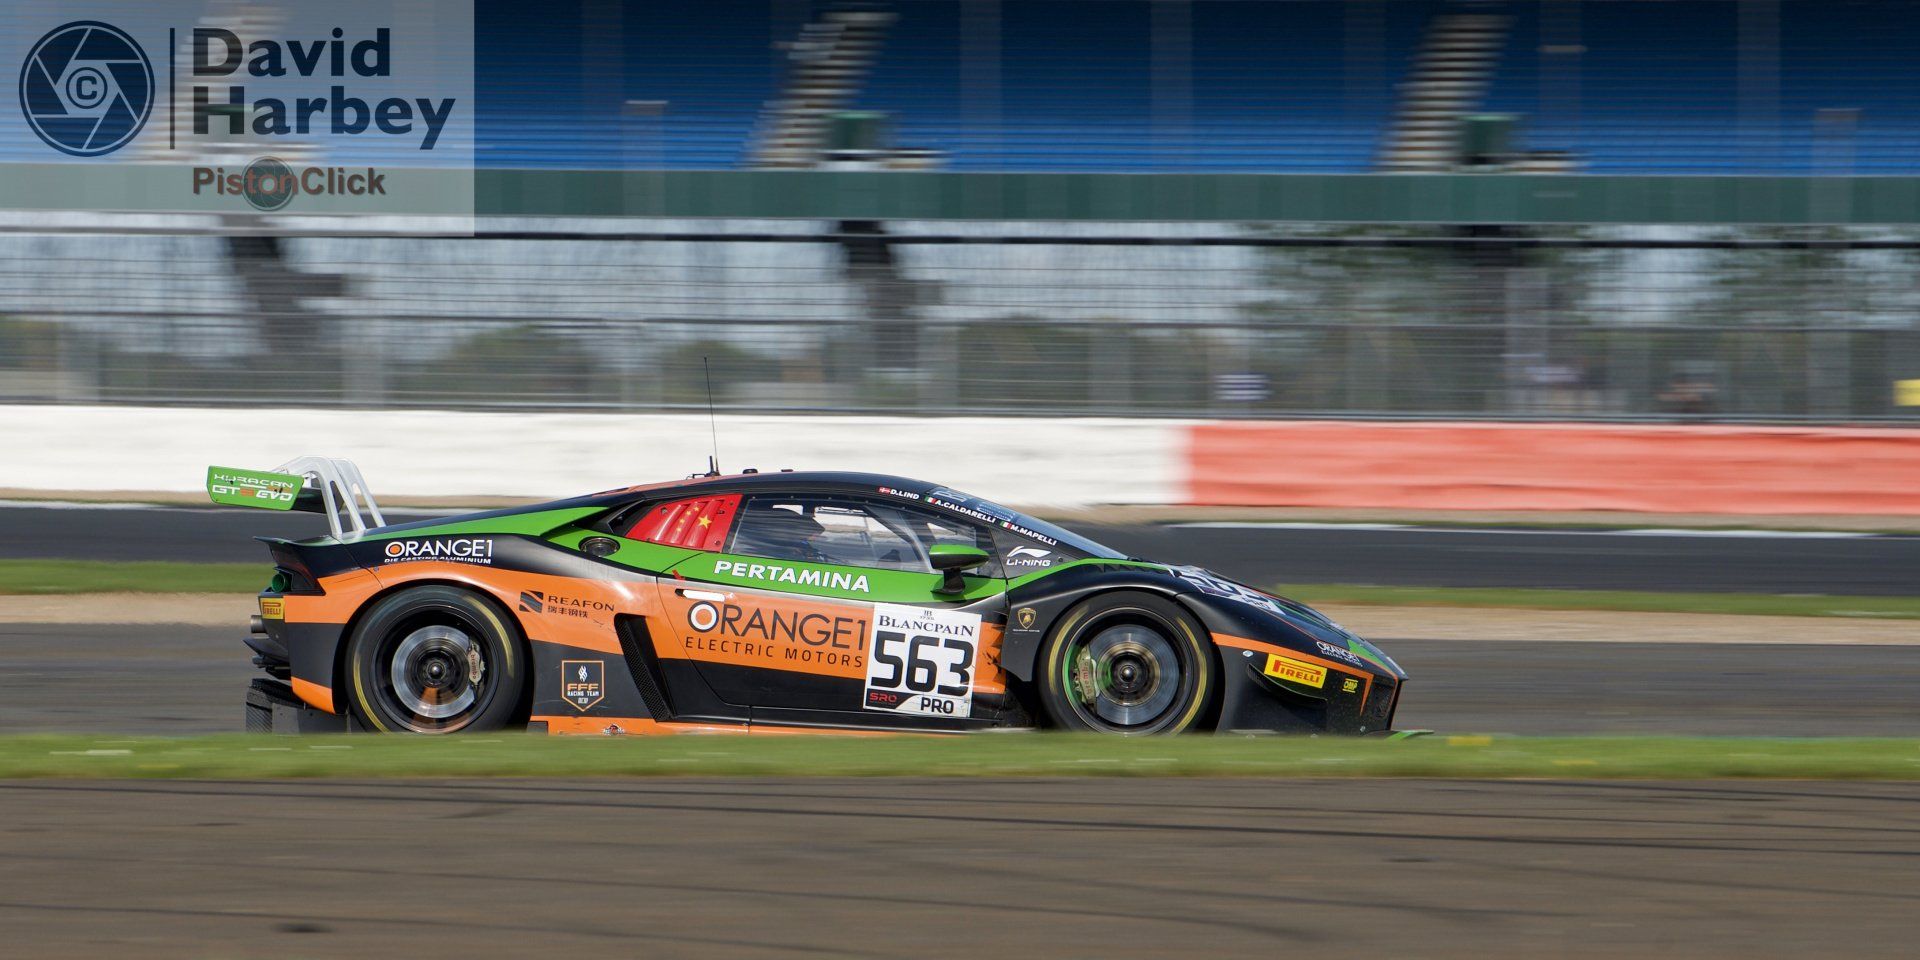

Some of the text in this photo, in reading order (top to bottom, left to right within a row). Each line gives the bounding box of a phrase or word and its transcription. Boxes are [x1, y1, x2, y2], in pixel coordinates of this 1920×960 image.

[890, 488, 920, 500] D.LIND
[934, 500, 996, 524] A.CALDARELLI
[1010, 526, 1058, 546] M.MAPELLI
[385, 539, 493, 557] ORANGE1
[1006, 558, 1051, 567] LI-NING
[713, 560, 870, 593] PERTAMINA
[548, 595, 615, 612] REAFON
[687, 600, 867, 651] ORANGE1
[877, 614, 975, 637] BLANCPAIN
[684, 636, 863, 668] ELECTRIC MOTORS
[870, 630, 975, 697] 563
[1272, 660, 1322, 683] PIRELLI
[869, 692, 897, 703] SRO
[920, 697, 954, 714] PRO
